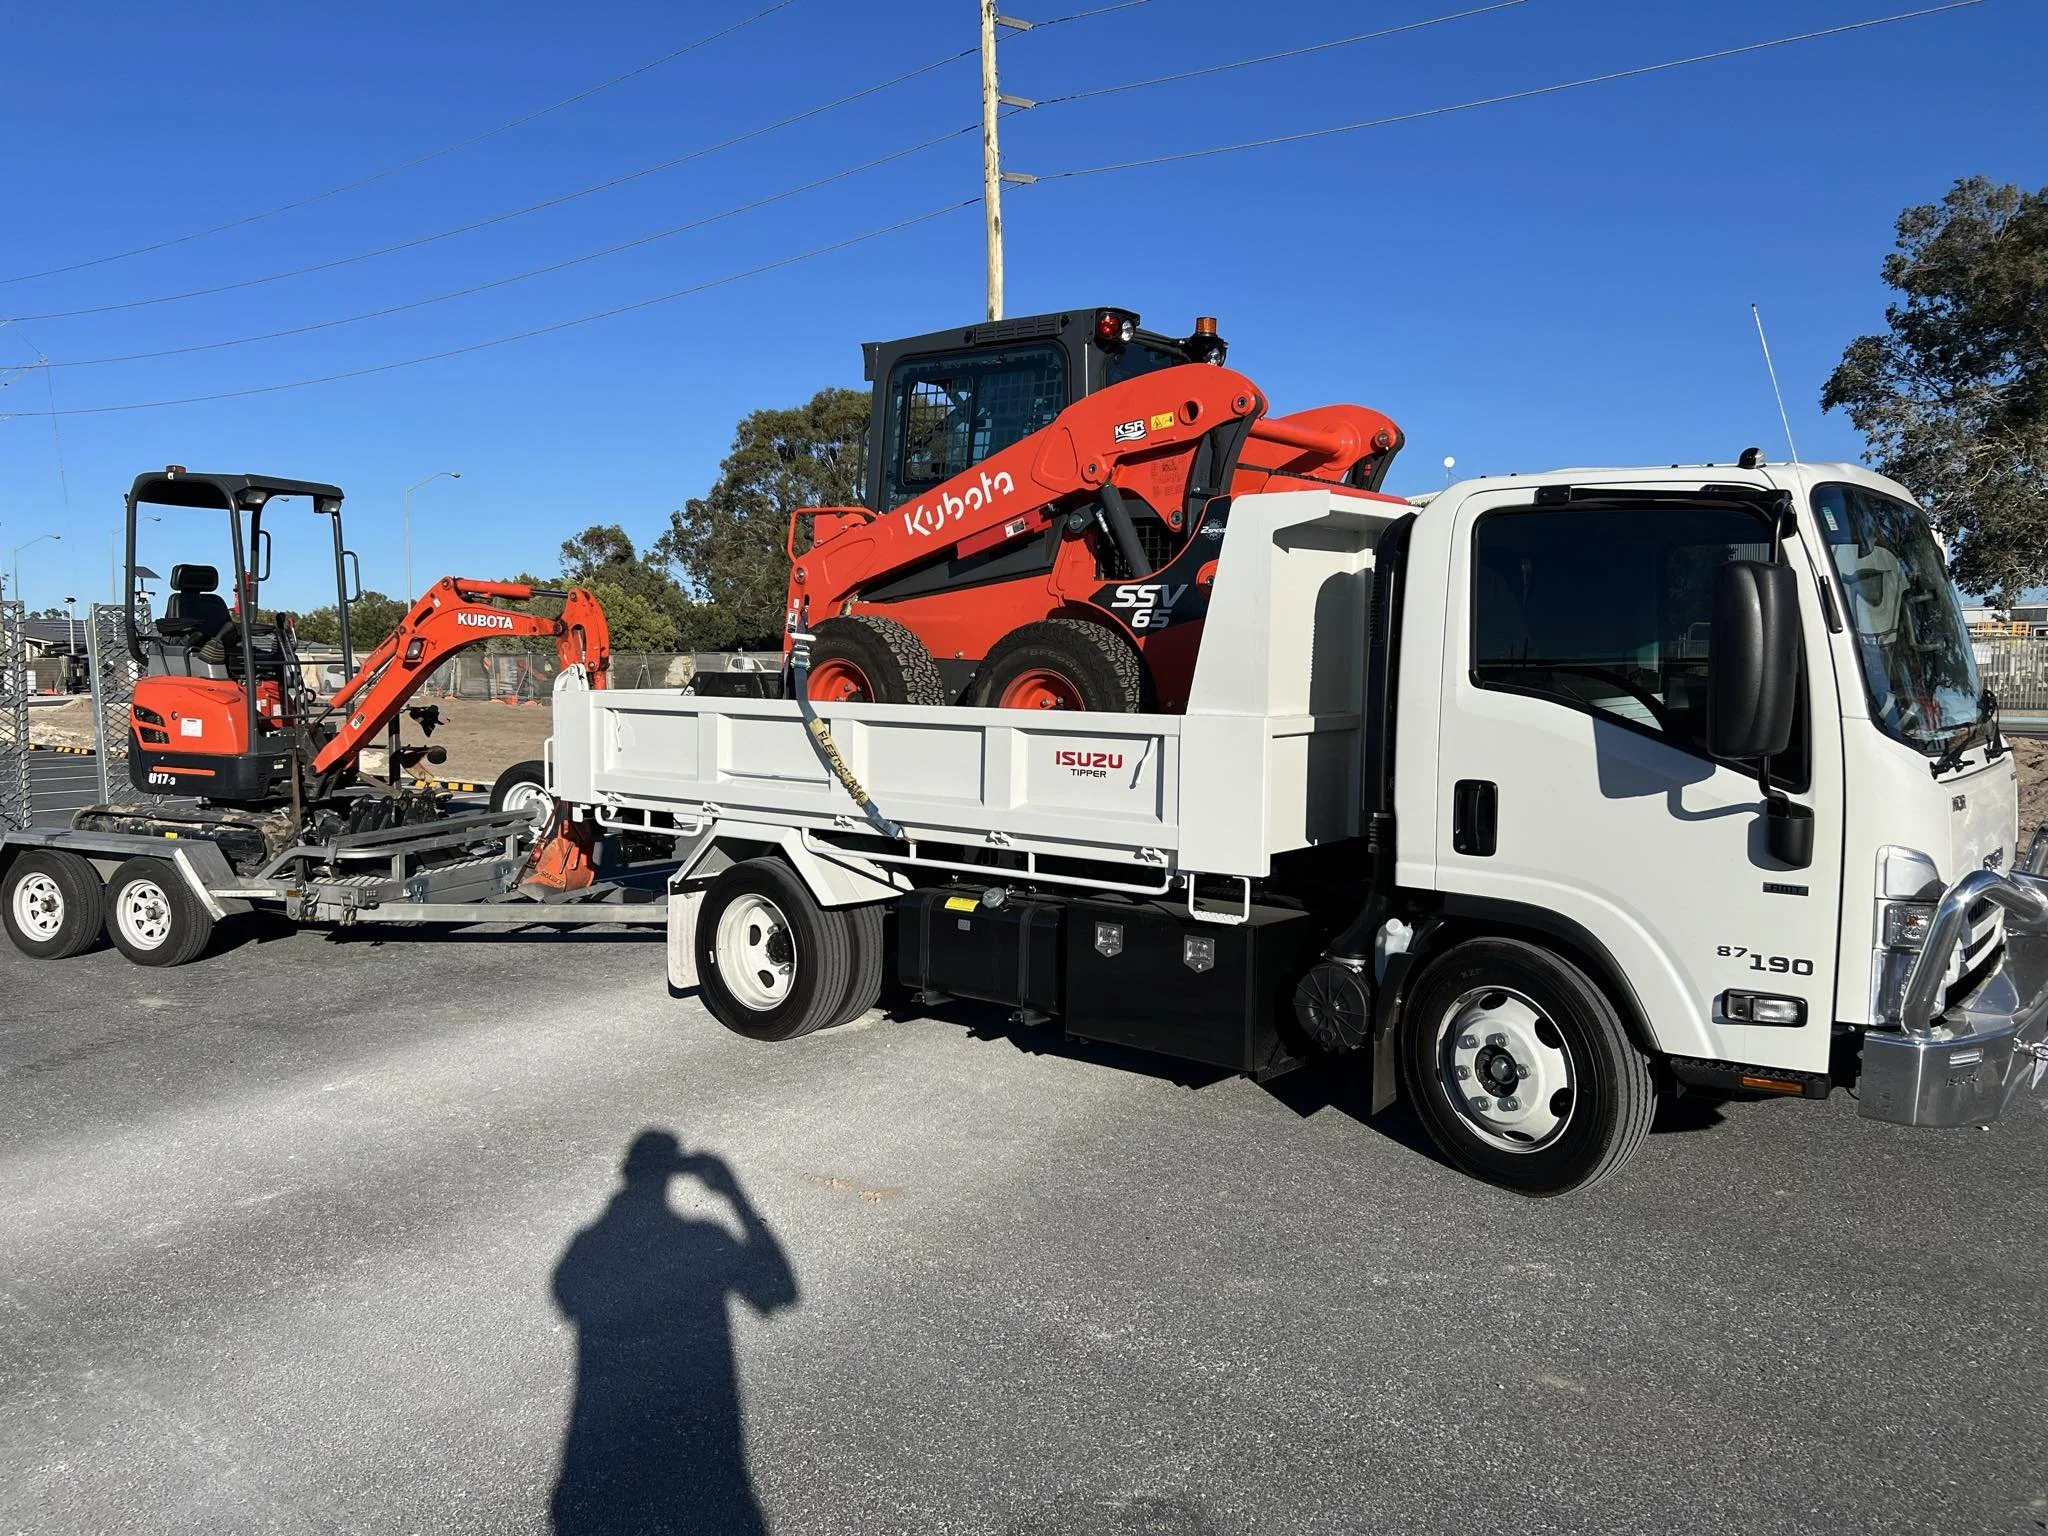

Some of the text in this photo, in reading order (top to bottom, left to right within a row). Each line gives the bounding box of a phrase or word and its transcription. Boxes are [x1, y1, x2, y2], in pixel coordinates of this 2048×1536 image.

[1115, 420, 1145, 436] KSR
[904, 471, 1015, 537] Kubota
[1111, 584, 1189, 608] SSV
[457, 612, 514, 630] KUBOTA
[1131, 609, 1172, 628] 65
[1056, 751, 1123, 769] ISUZU
[148, 772, 176, 786] U17-3
[1071, 768, 1107, 778] TIPPER
[1717, 945, 1814, 976] 87 190
